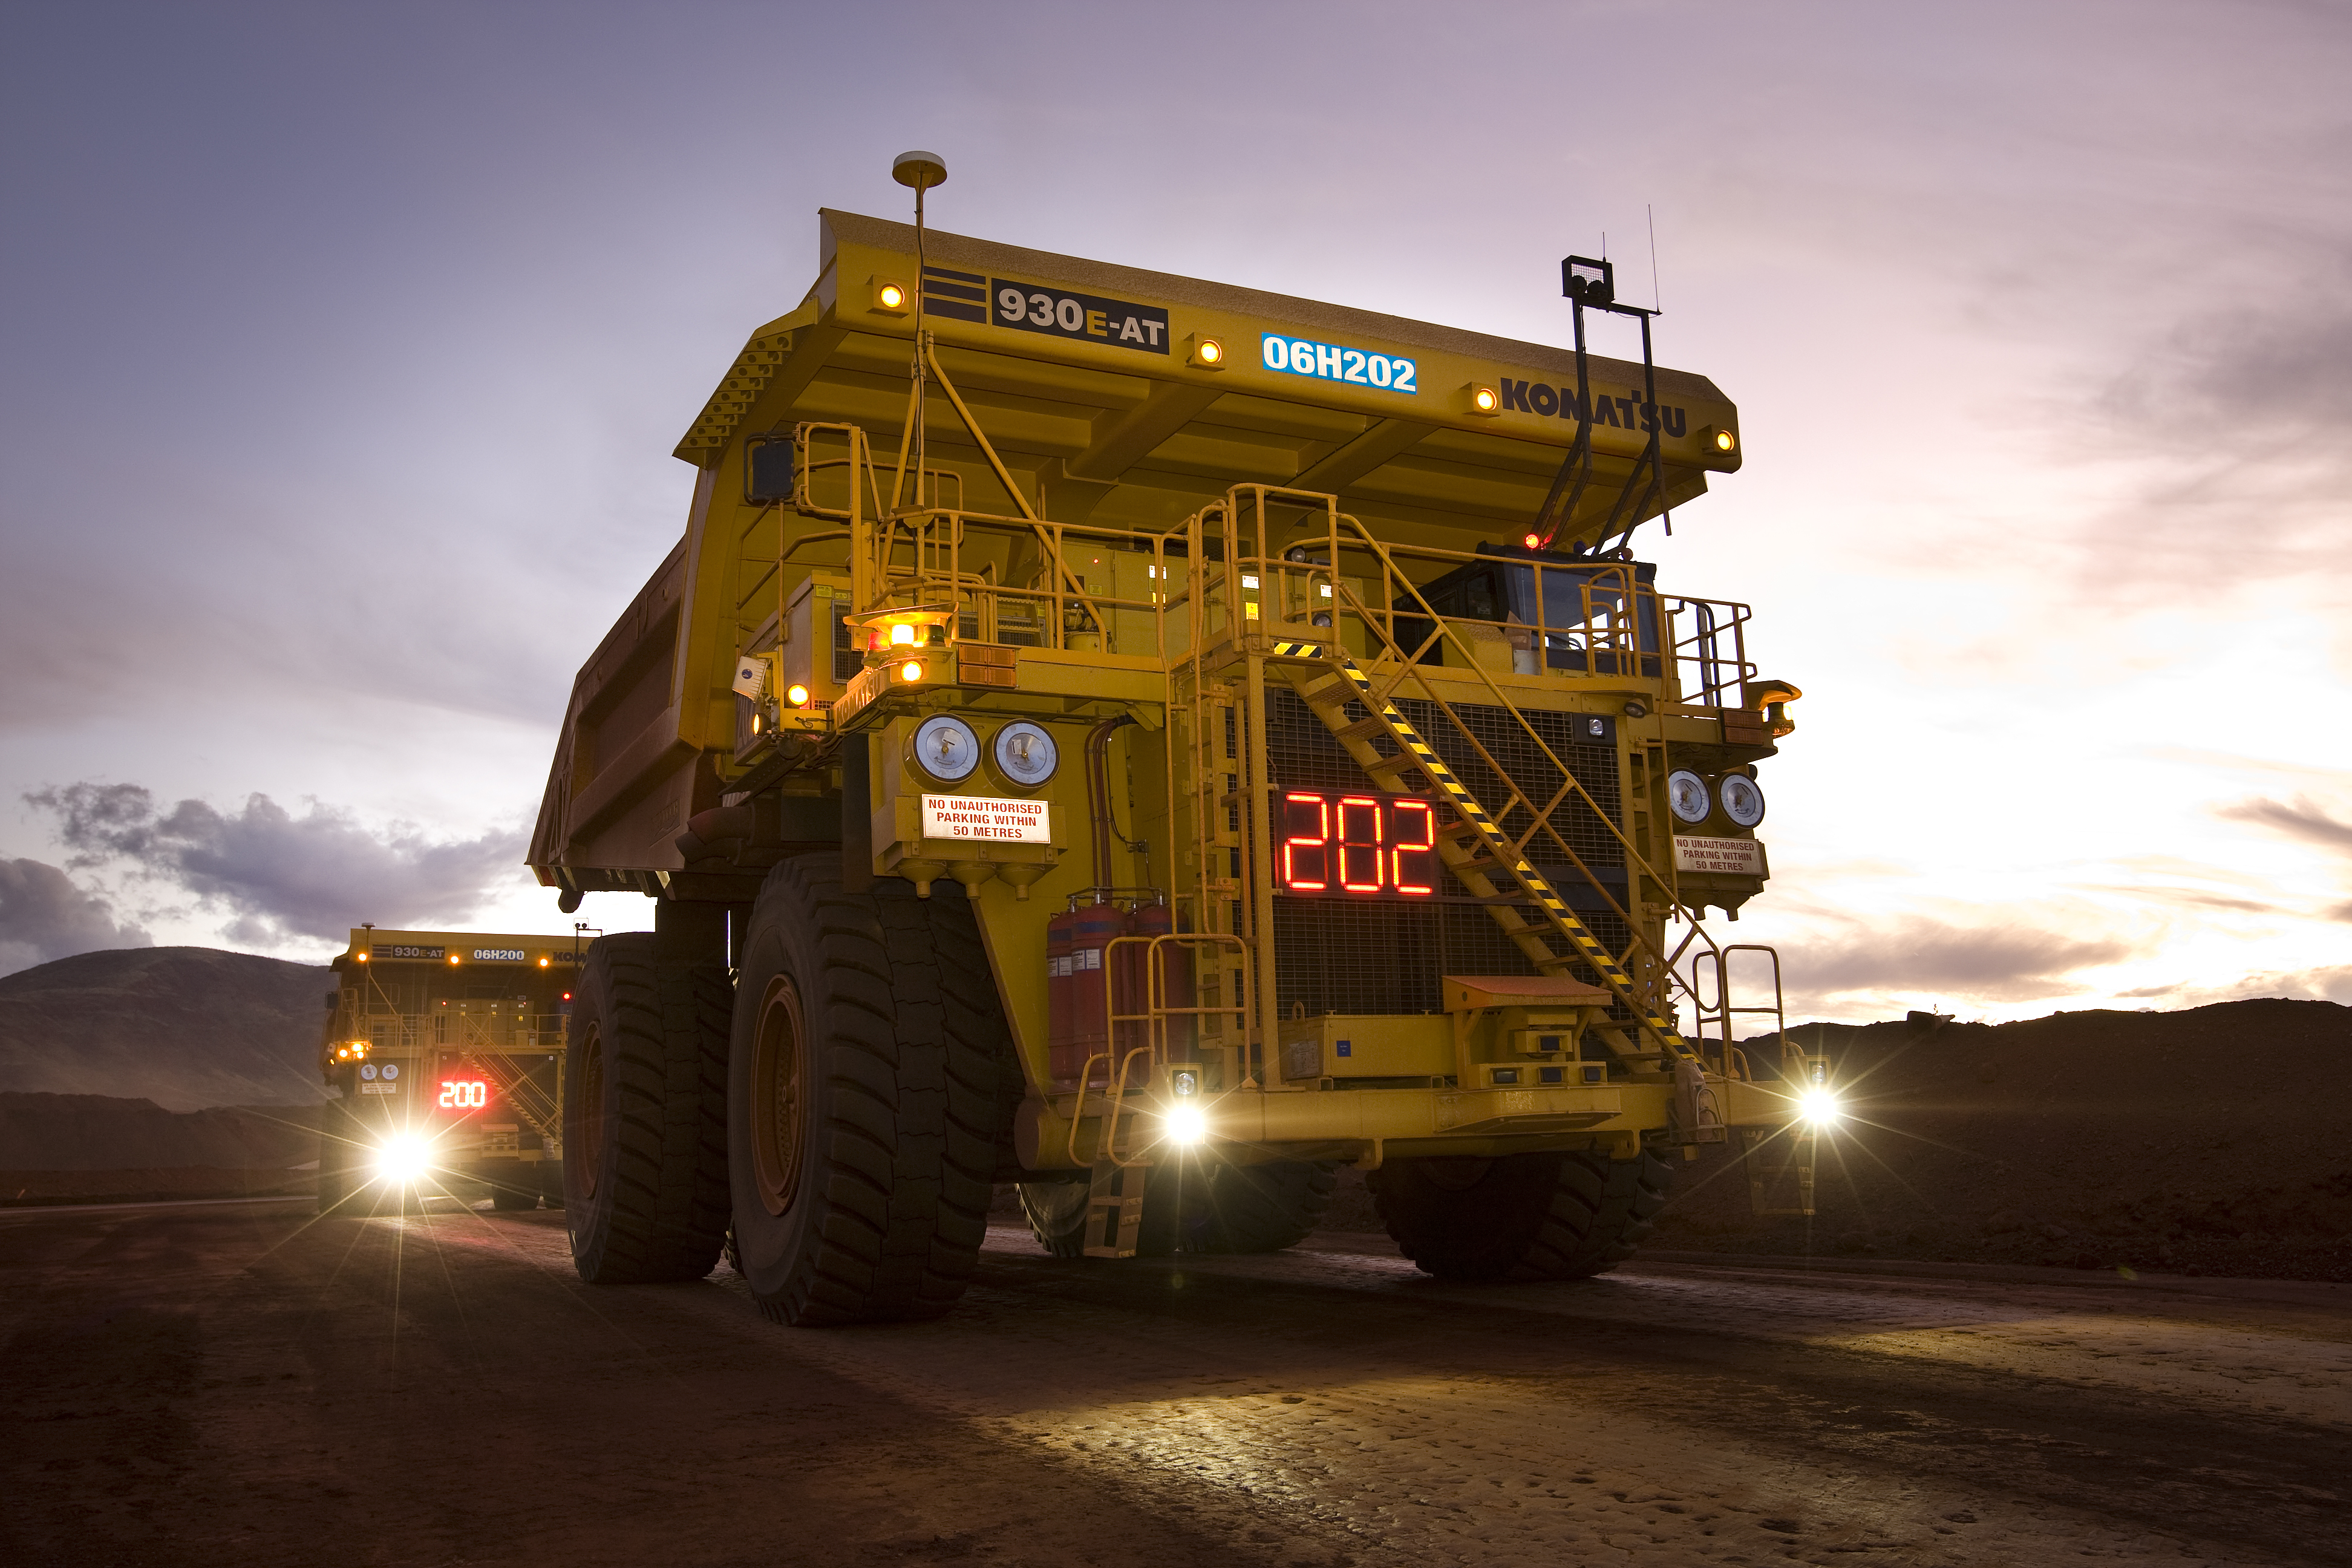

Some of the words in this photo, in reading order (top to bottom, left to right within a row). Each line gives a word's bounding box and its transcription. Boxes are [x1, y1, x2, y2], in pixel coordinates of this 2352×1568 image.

[998, 288, 1165, 345] 930E-AT
[1263, 336, 1416, 392] 06H202
[1500, 377, 1687, 438] KOMATSU
[929, 799, 945, 809] NO
[950, 800, 1042, 814] UNAUTHORISED
[937, 812, 990, 824] PARKING
[995, 815, 1036, 826] WITHIN
[953, 826, 969, 835] 50
[973, 826, 1022, 838] METRES
[1284, 793, 1433, 895] 202
[1676, 839, 1688, 848] NO
[1691, 840, 1754, 851] UNAUTHORISED
[1683, 849, 1720, 860] PARKING
[1722, 852, 1752, 861] WITHIN
[1696, 861, 1707, 869] 50
[1710, 861, 1743, 871] METRES
[394, 947, 444, 958] 930E-AT
[474, 949, 525, 960] 06H200
[439, 1082, 486, 1108] 200
